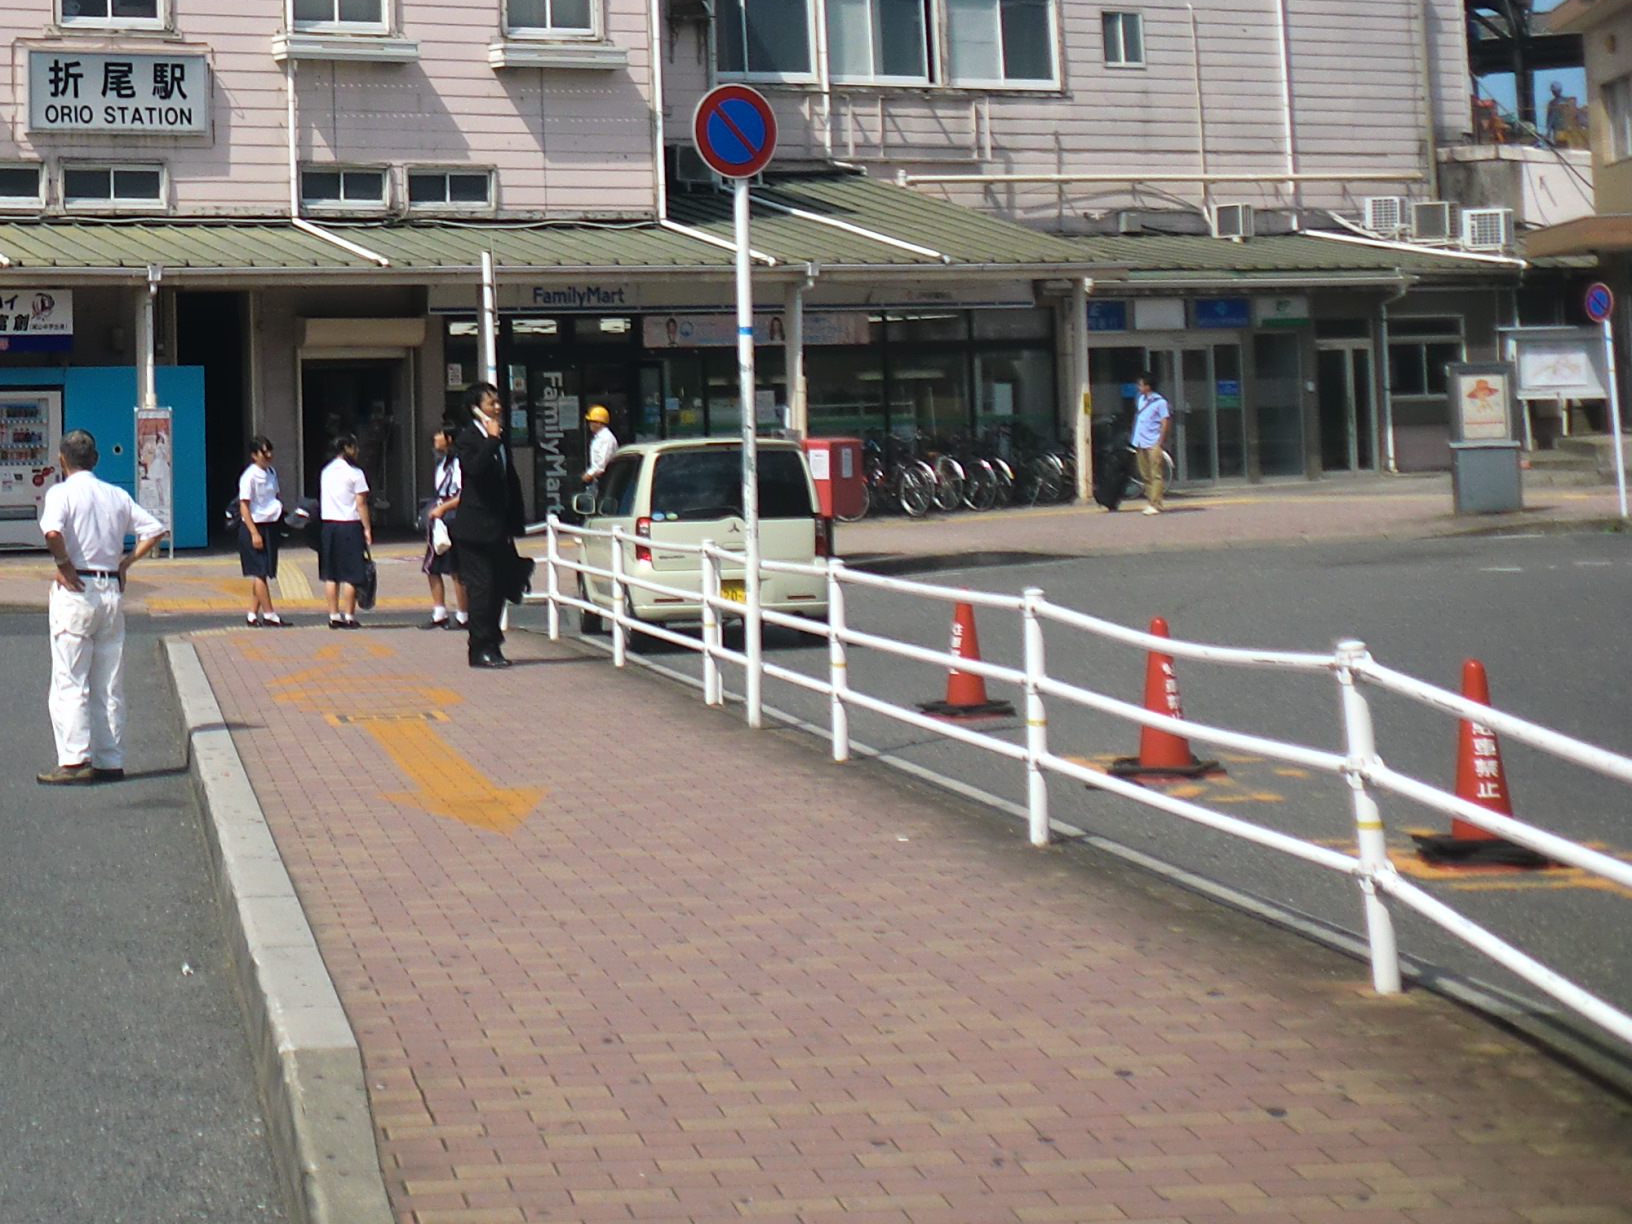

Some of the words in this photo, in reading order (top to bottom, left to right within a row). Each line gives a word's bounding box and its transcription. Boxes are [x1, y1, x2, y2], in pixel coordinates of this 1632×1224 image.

[48, 59, 187, 100] 折尾駅
[45, 105, 93, 124] ORIO
[104, 106, 192, 125] STATION
[533, 287, 625, 307] FamilyMart
[539, 372, 567, 515] FamilyMart
